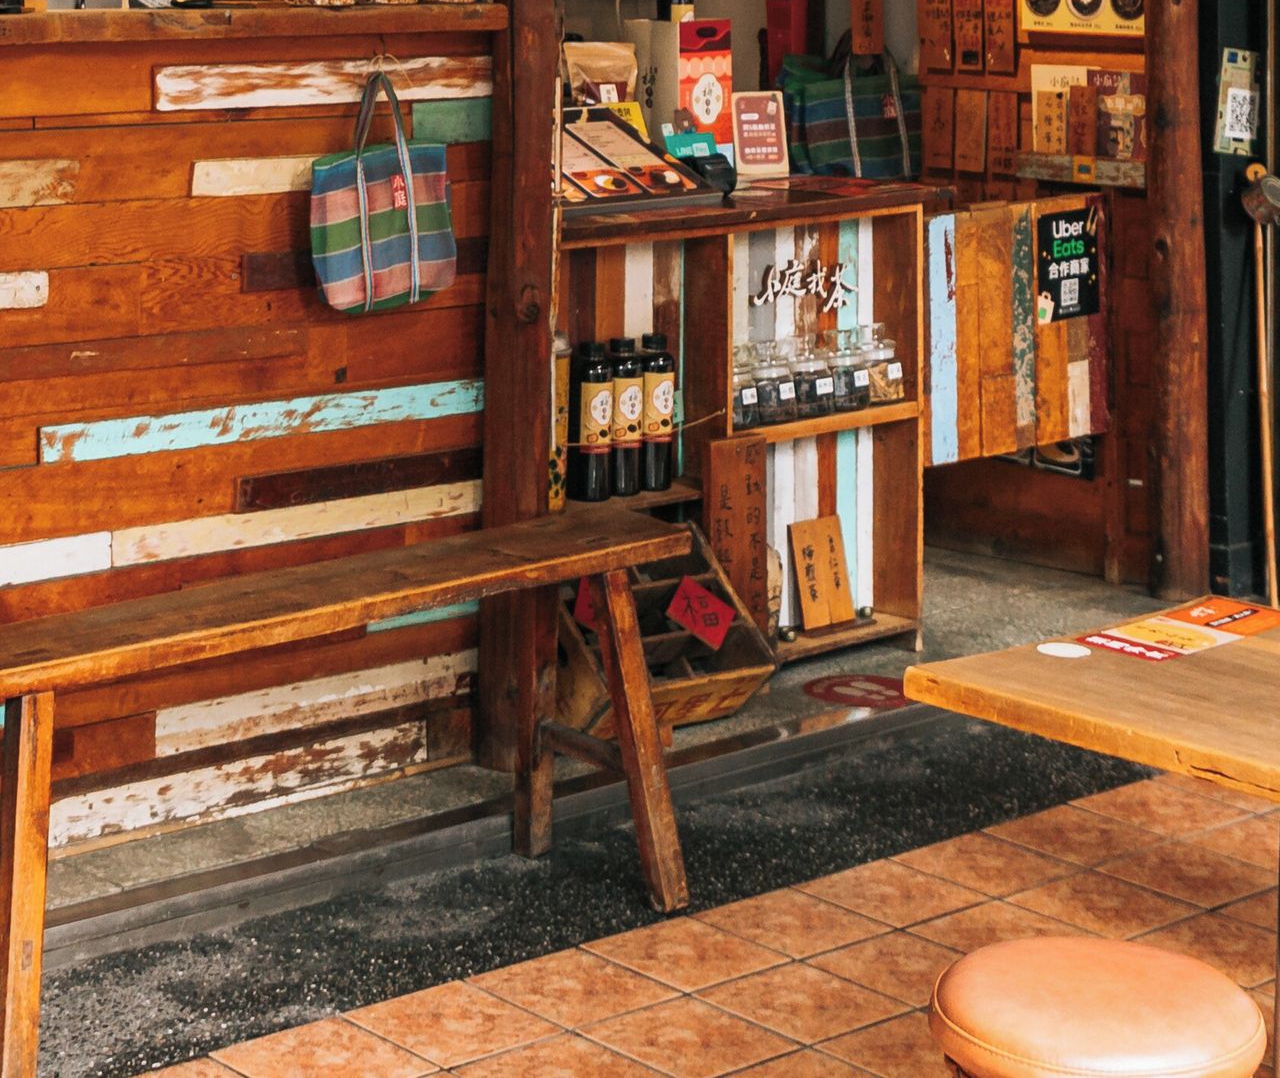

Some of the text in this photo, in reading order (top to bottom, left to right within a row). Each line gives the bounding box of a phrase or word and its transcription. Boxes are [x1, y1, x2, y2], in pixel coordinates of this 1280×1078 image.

[393, 174, 408, 208] 小庭
[1052, 219, 1084, 239] Uber
[1052, 239, 1085, 259] Eats
[1048, 257, 1090, 280] 合作商家
[680, 589, 721, 628] 福
